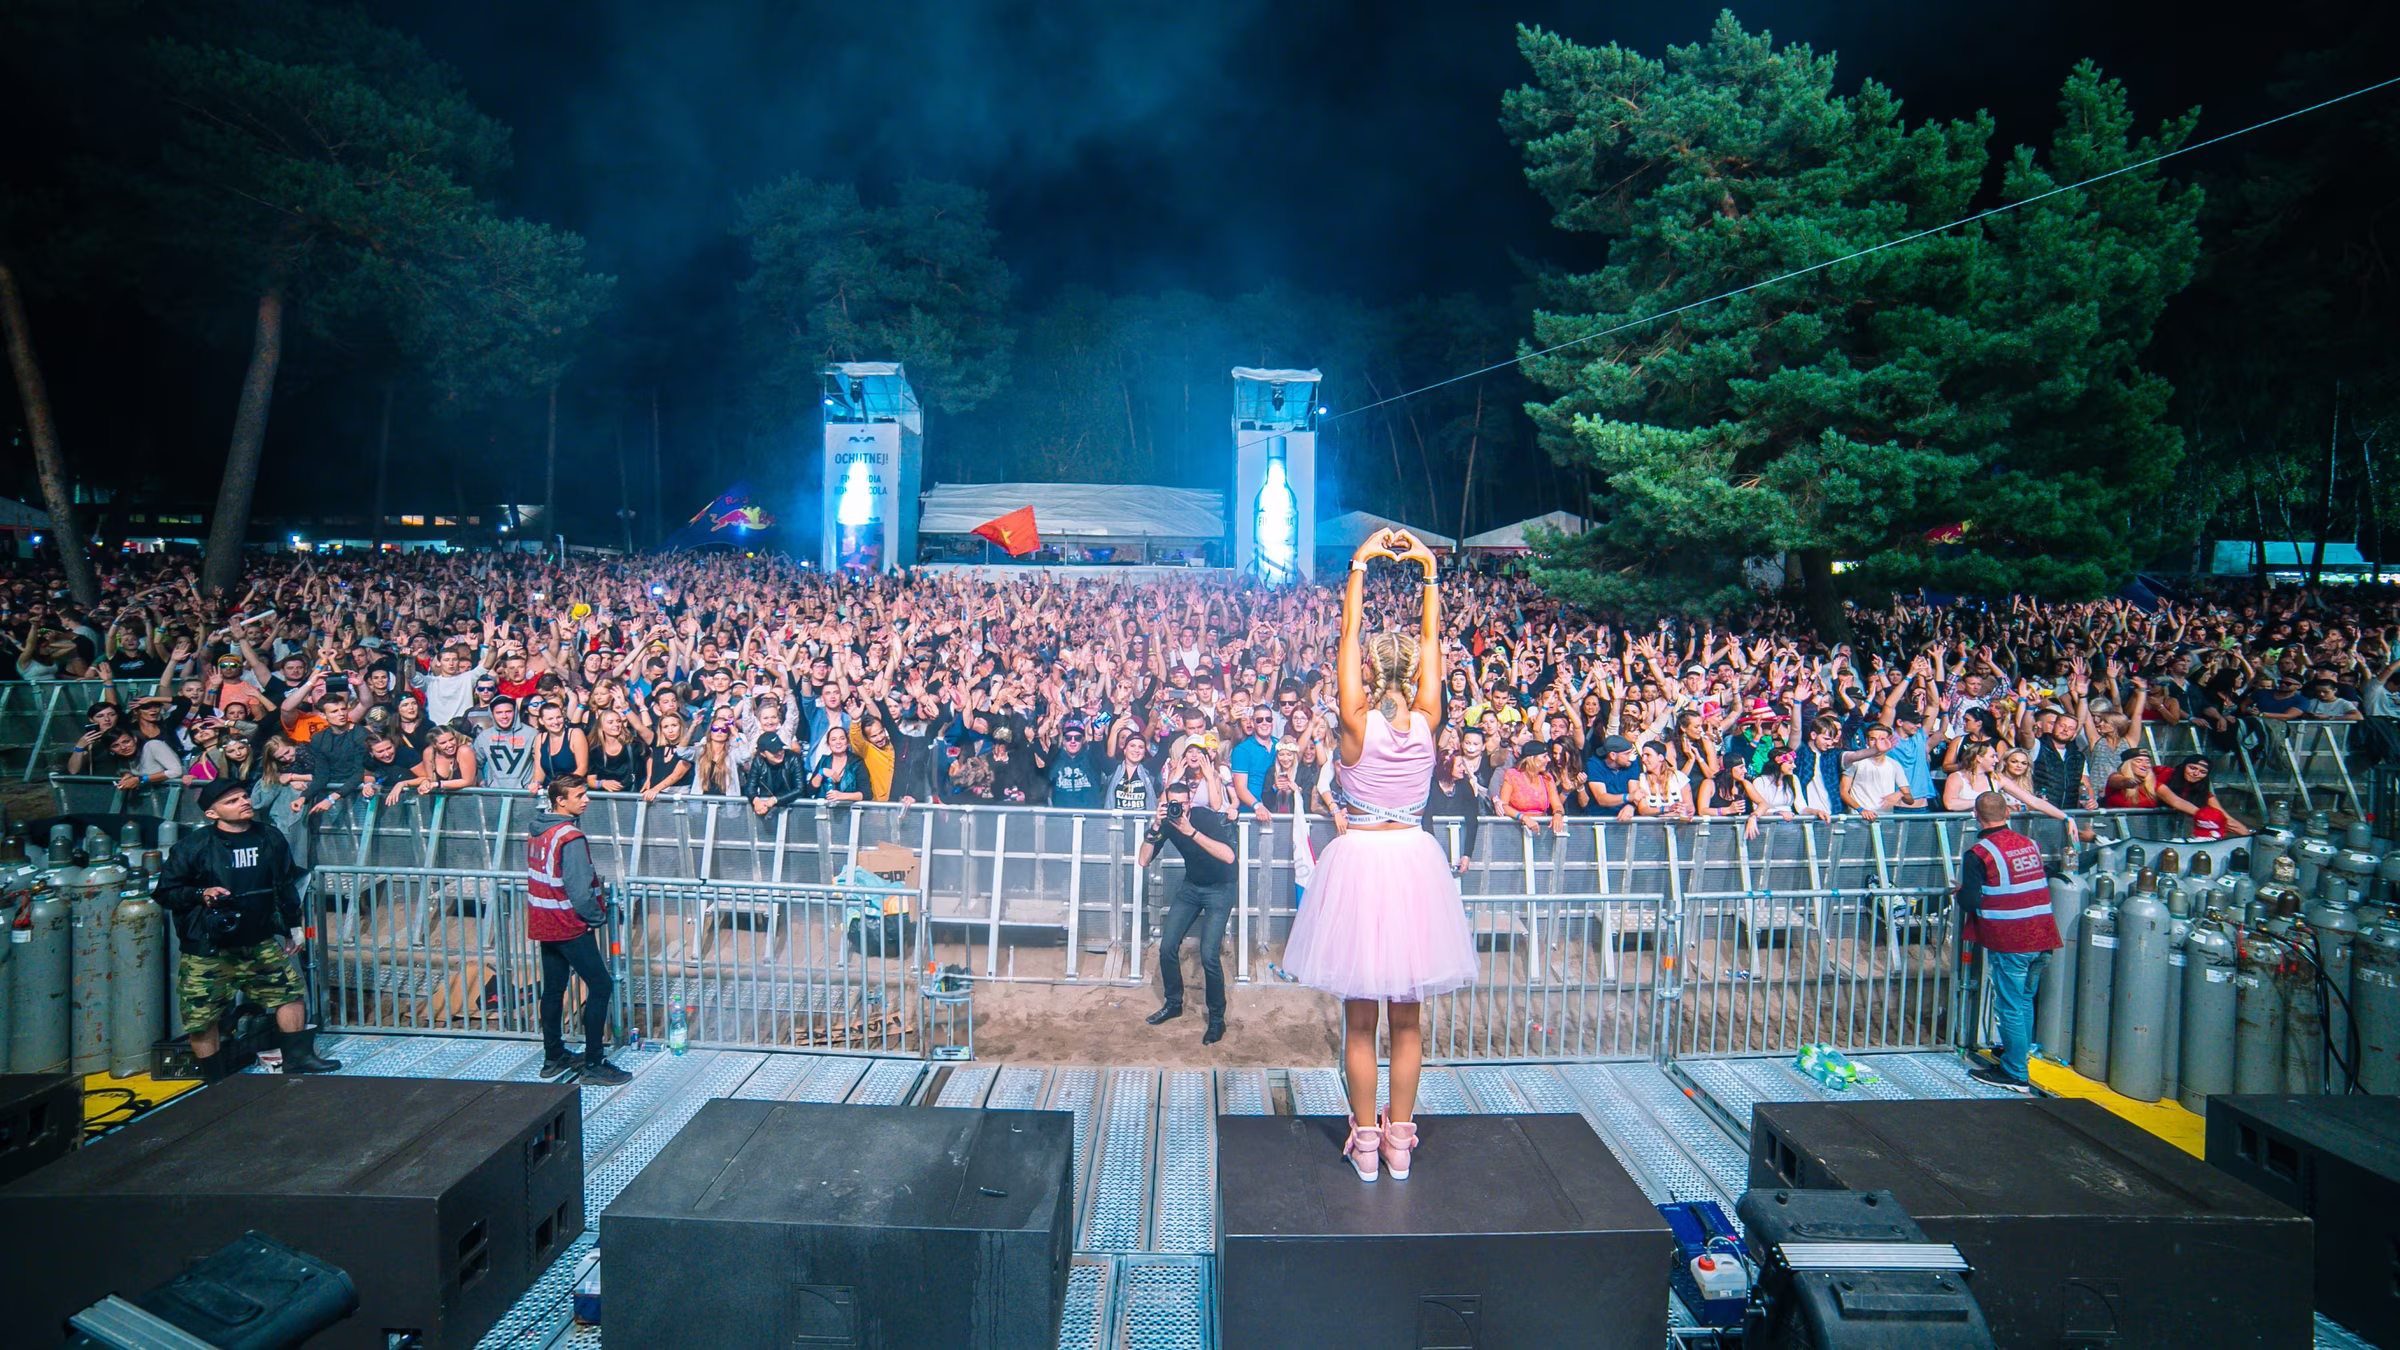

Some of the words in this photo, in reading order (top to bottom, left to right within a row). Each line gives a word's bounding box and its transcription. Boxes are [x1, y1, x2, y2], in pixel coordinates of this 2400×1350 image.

[834, 452, 889, 466] OCHUTNEJ!
[231, 846, 259, 869] TAFF
[2005, 846, 2036, 858] SECURITY
